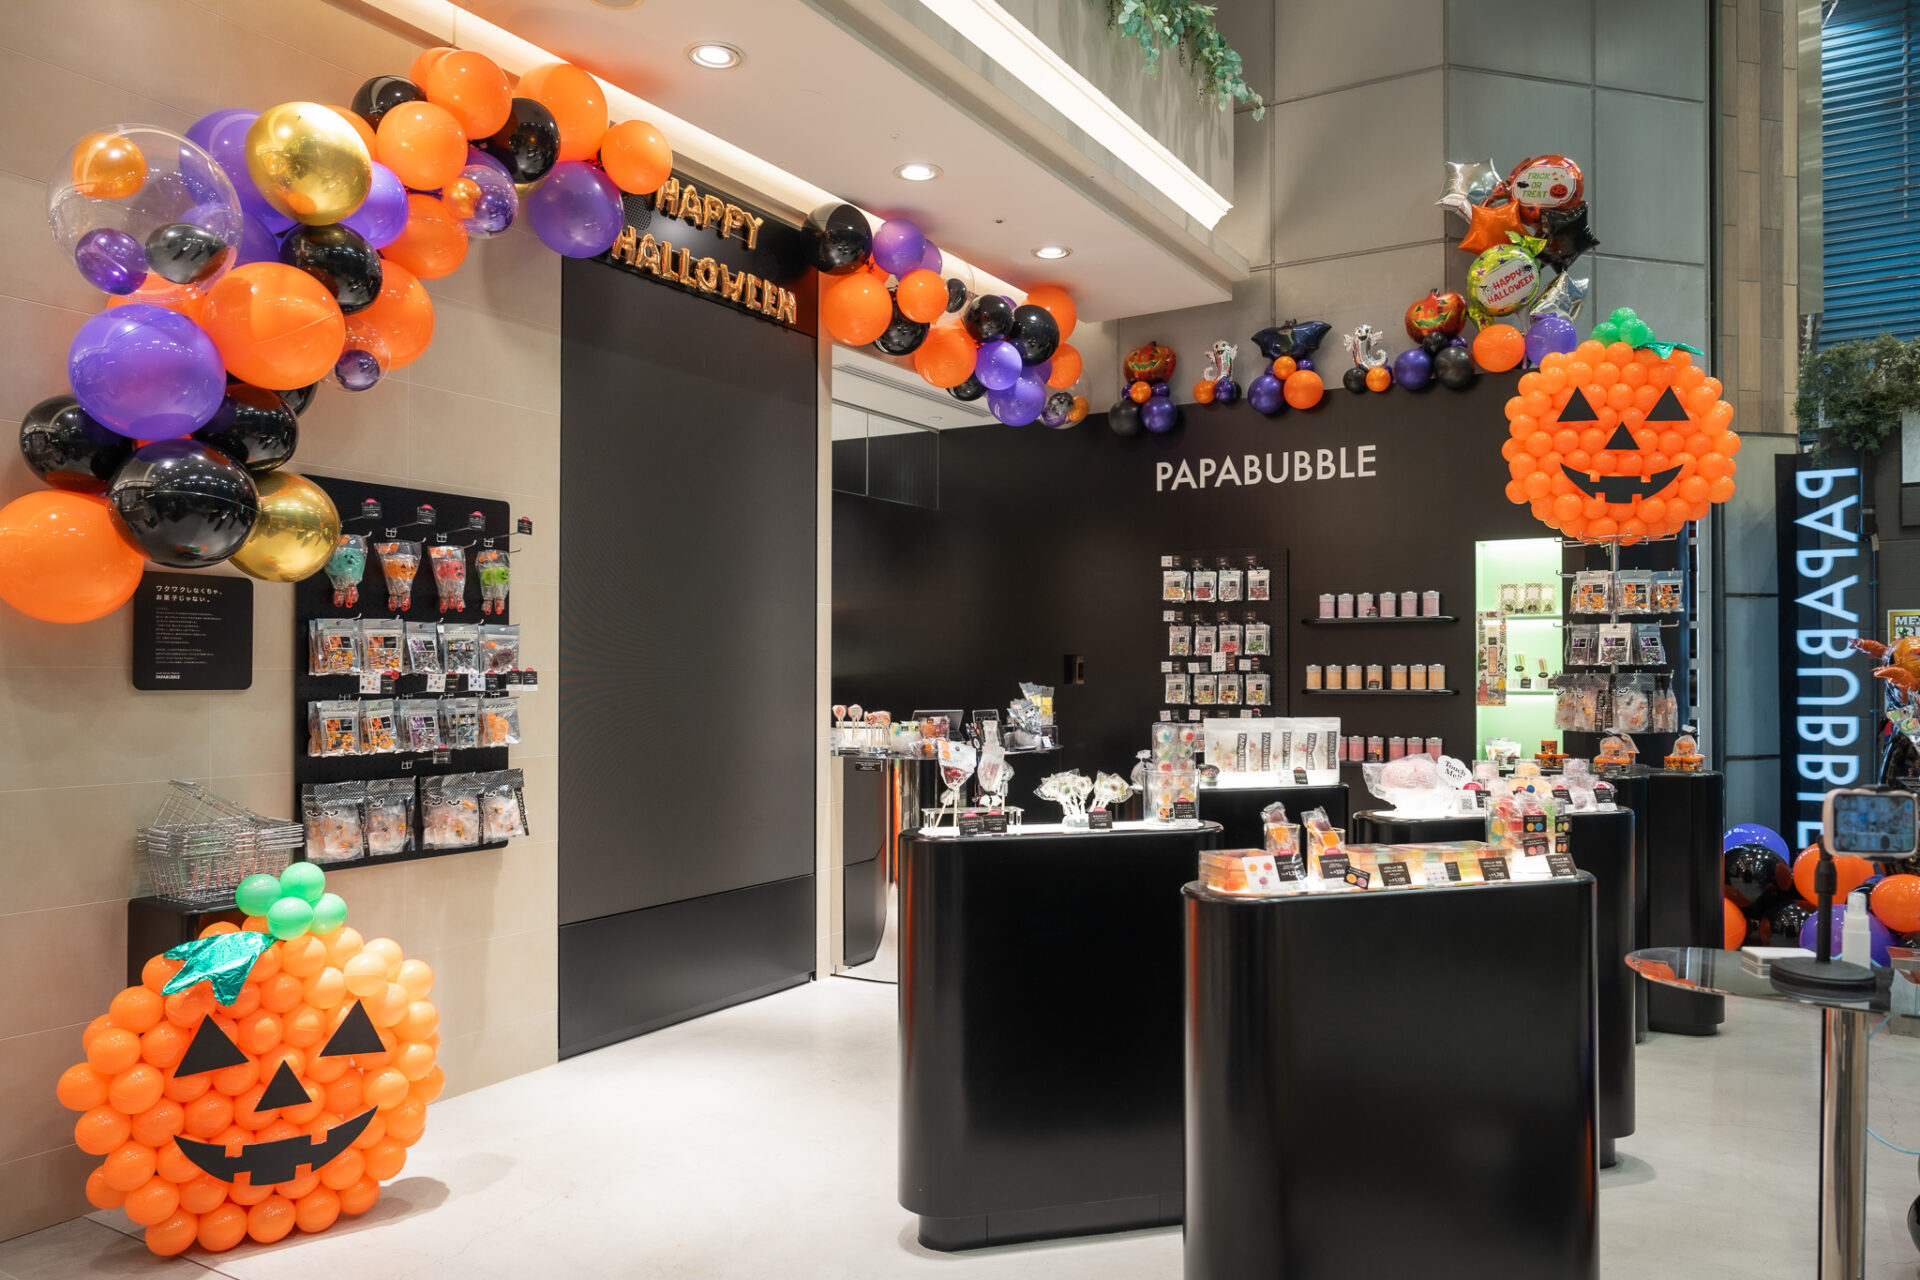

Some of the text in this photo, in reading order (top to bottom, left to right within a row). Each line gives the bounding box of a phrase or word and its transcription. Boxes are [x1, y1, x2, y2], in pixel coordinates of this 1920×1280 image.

[1527, 171, 1551, 180] TRICK
[1531, 181, 1543, 189] OR
[1522, 190, 1548, 198] TREAT
[656, 176, 764, 250] HAPPY
[611, 224, 797, 325] HALLOWEEN
[1492, 267, 1523, 290] HAPPY
[1486, 274, 1535, 304] HALLOWEEN
[1156, 444, 1377, 492] PAPABUBBLE
[1445, 760, 1466, 776] Touch
